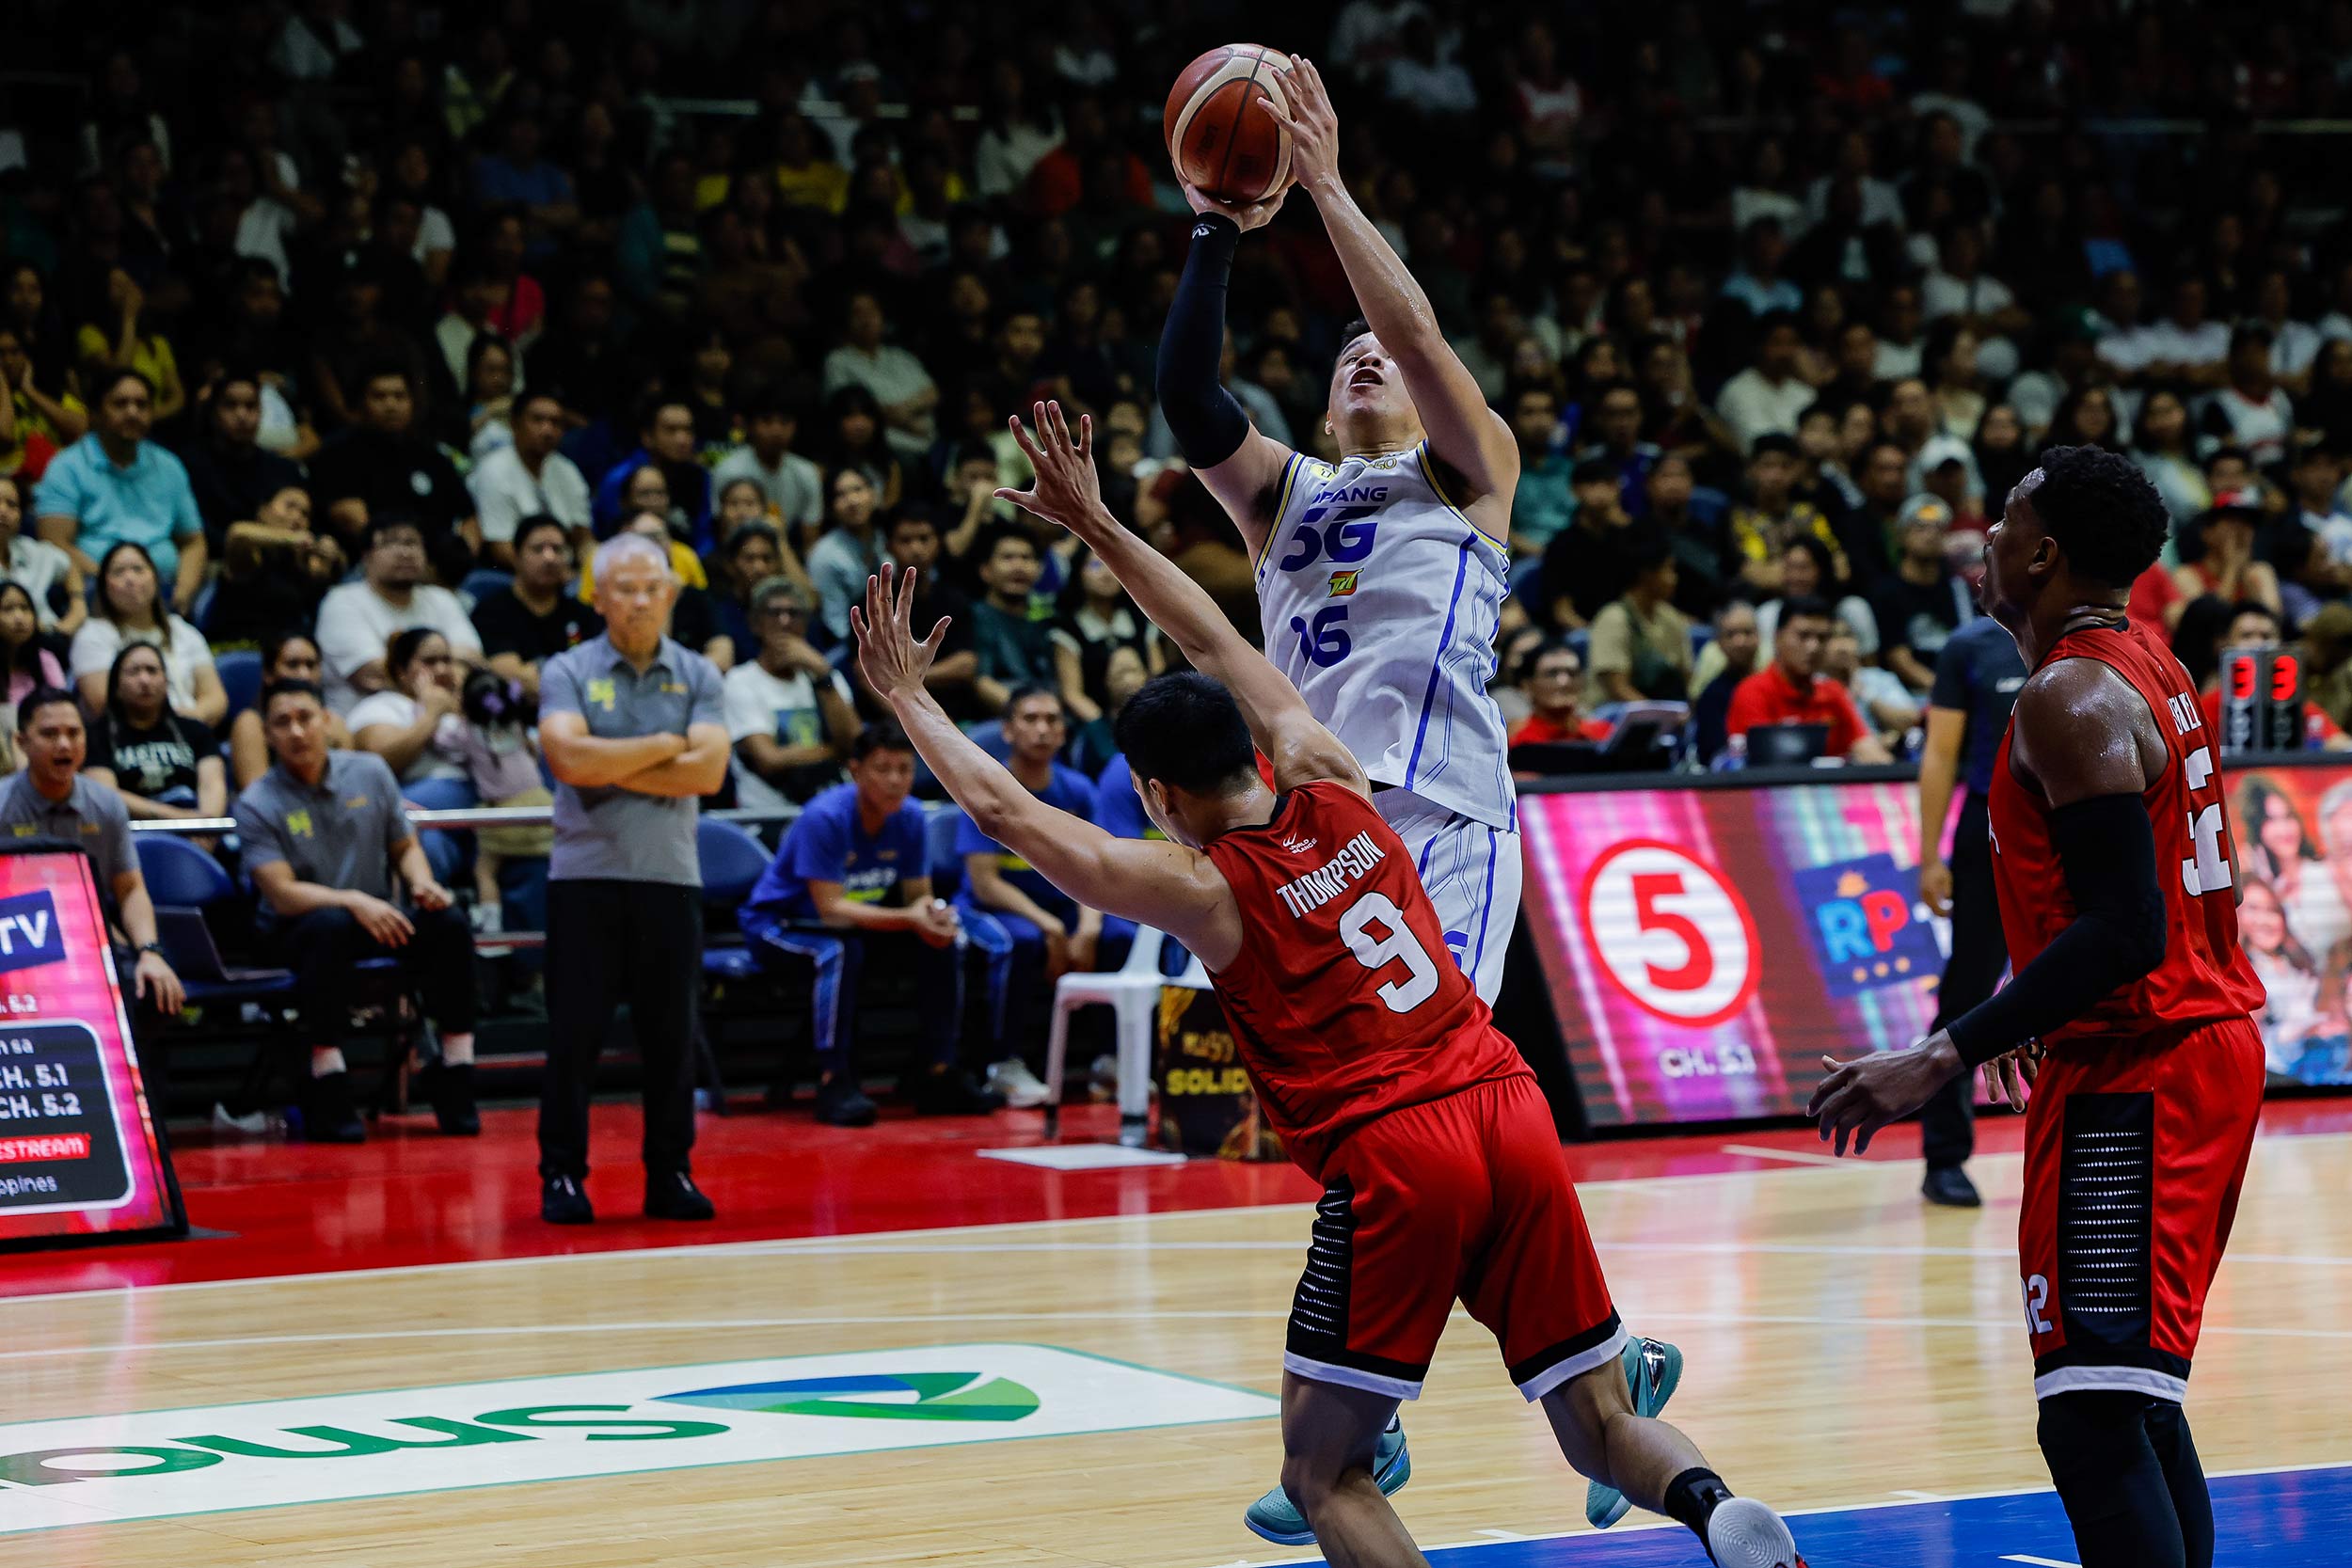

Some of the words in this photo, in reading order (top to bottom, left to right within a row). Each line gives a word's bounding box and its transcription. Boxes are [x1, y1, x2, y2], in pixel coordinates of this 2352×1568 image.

[1279, 505, 1381, 572] 5G
[1277, 830, 1386, 918] THOMPSON
[1339, 891, 1439, 1014] 9
[1631, 873, 1714, 991] 5
[0, 1095, 40, 1119] CH.
[41, 1092, 83, 1117] 5.2
[35, 1062, 69, 1087] 5.1
[0, 1404, 732, 1490] sma
